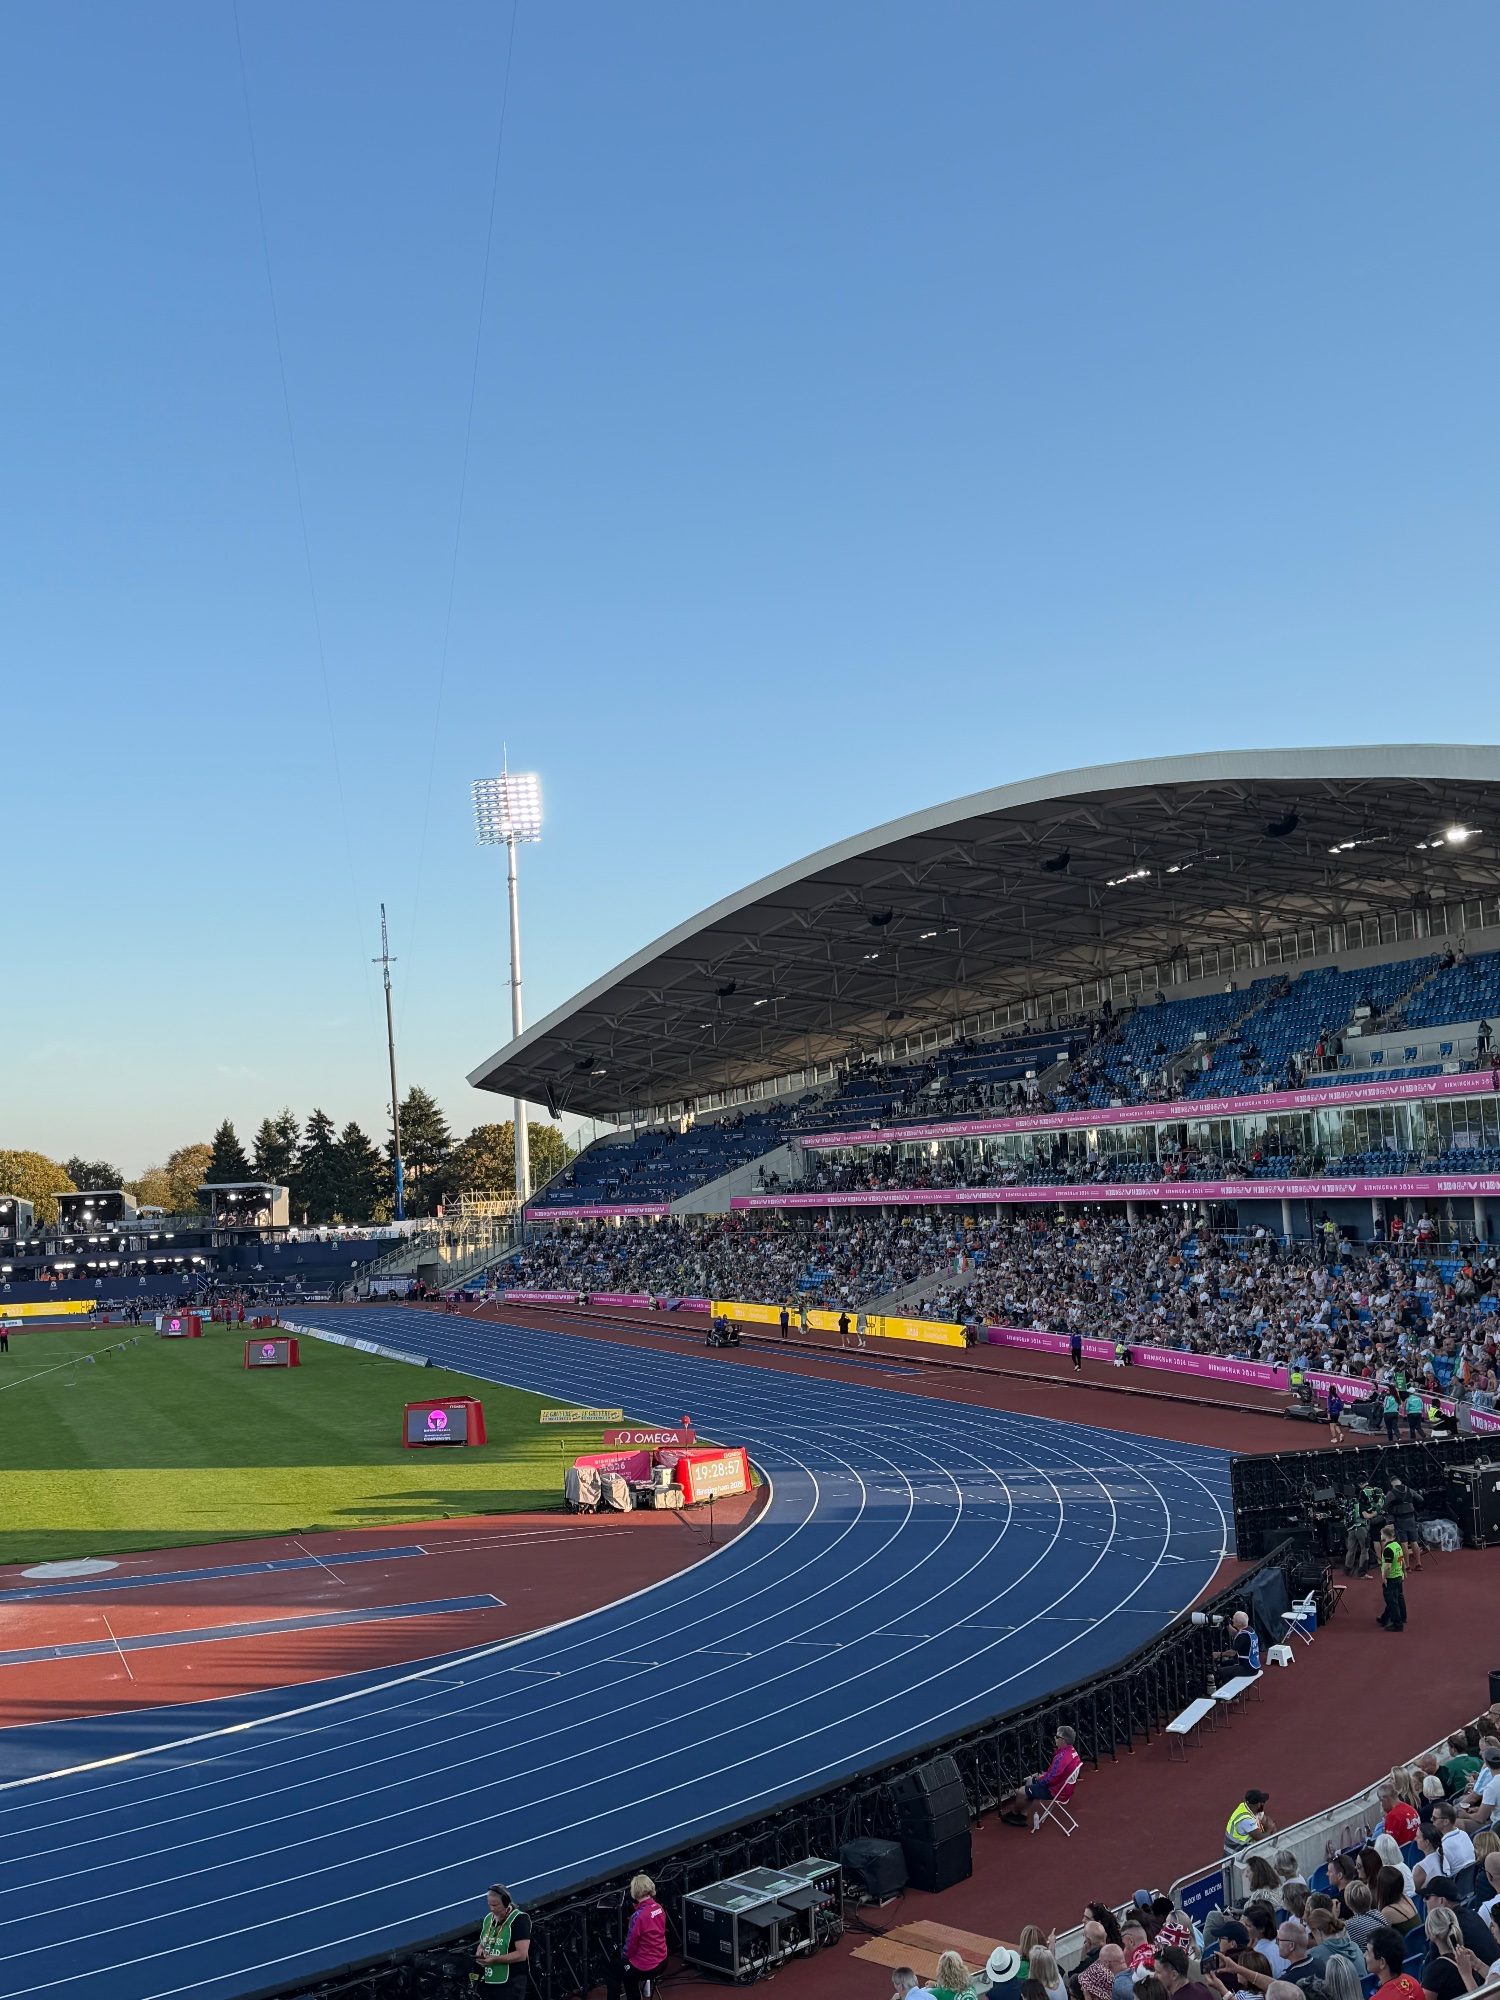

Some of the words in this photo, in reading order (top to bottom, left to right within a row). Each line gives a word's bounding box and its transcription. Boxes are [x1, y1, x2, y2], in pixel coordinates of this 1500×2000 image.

[634, 1433, 679, 1443] OMEGA
[695, 1460, 740, 1481] 19:28:57
[1183, 1895, 1196, 1907] BLOCK
